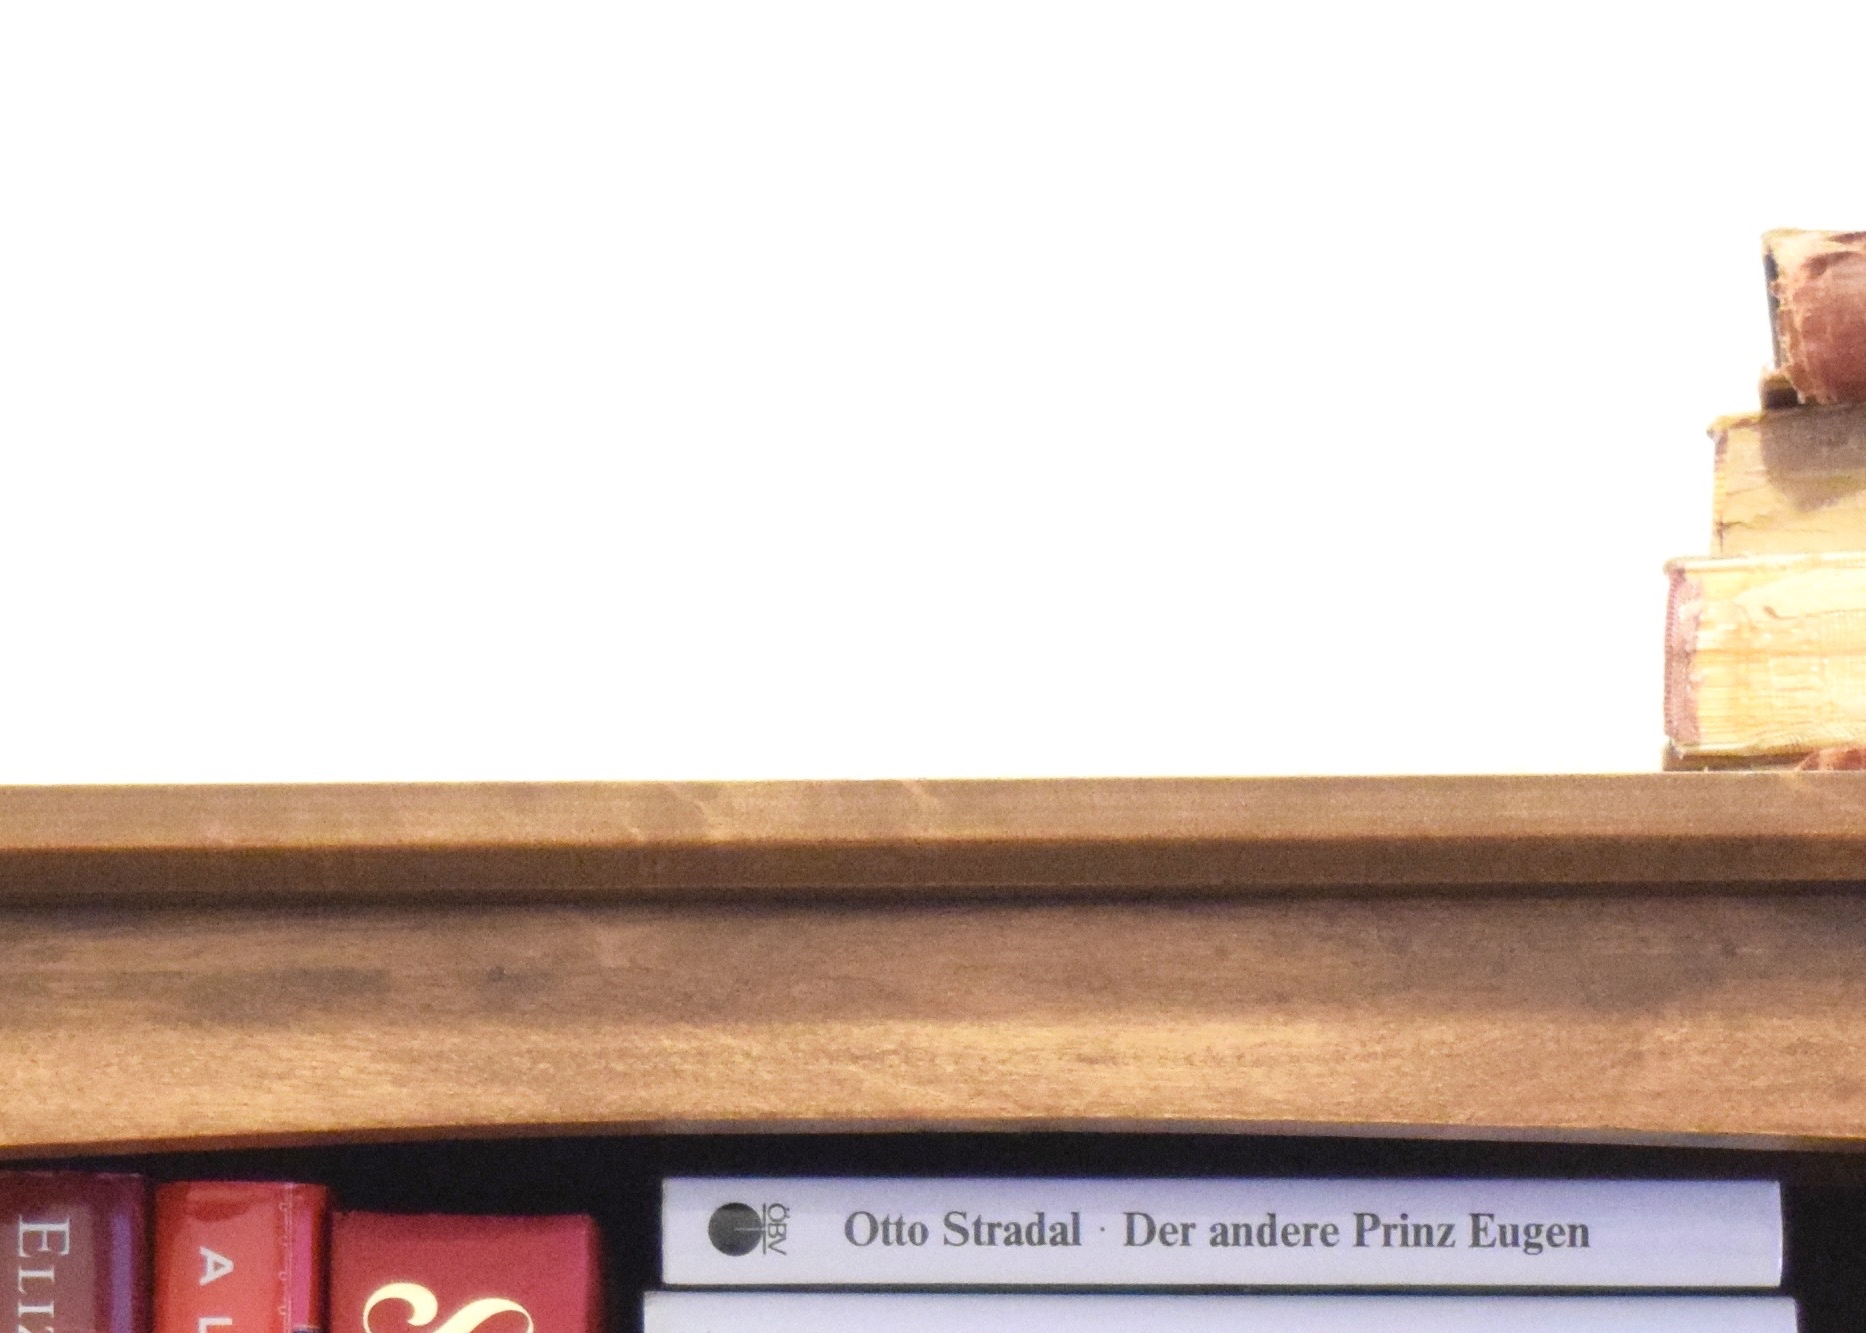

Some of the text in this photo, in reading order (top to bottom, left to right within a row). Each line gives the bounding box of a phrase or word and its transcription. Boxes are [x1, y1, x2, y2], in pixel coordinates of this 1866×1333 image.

[843, 1210, 1591, 1255] Otto Stradal Der andere Prinz Eugen
